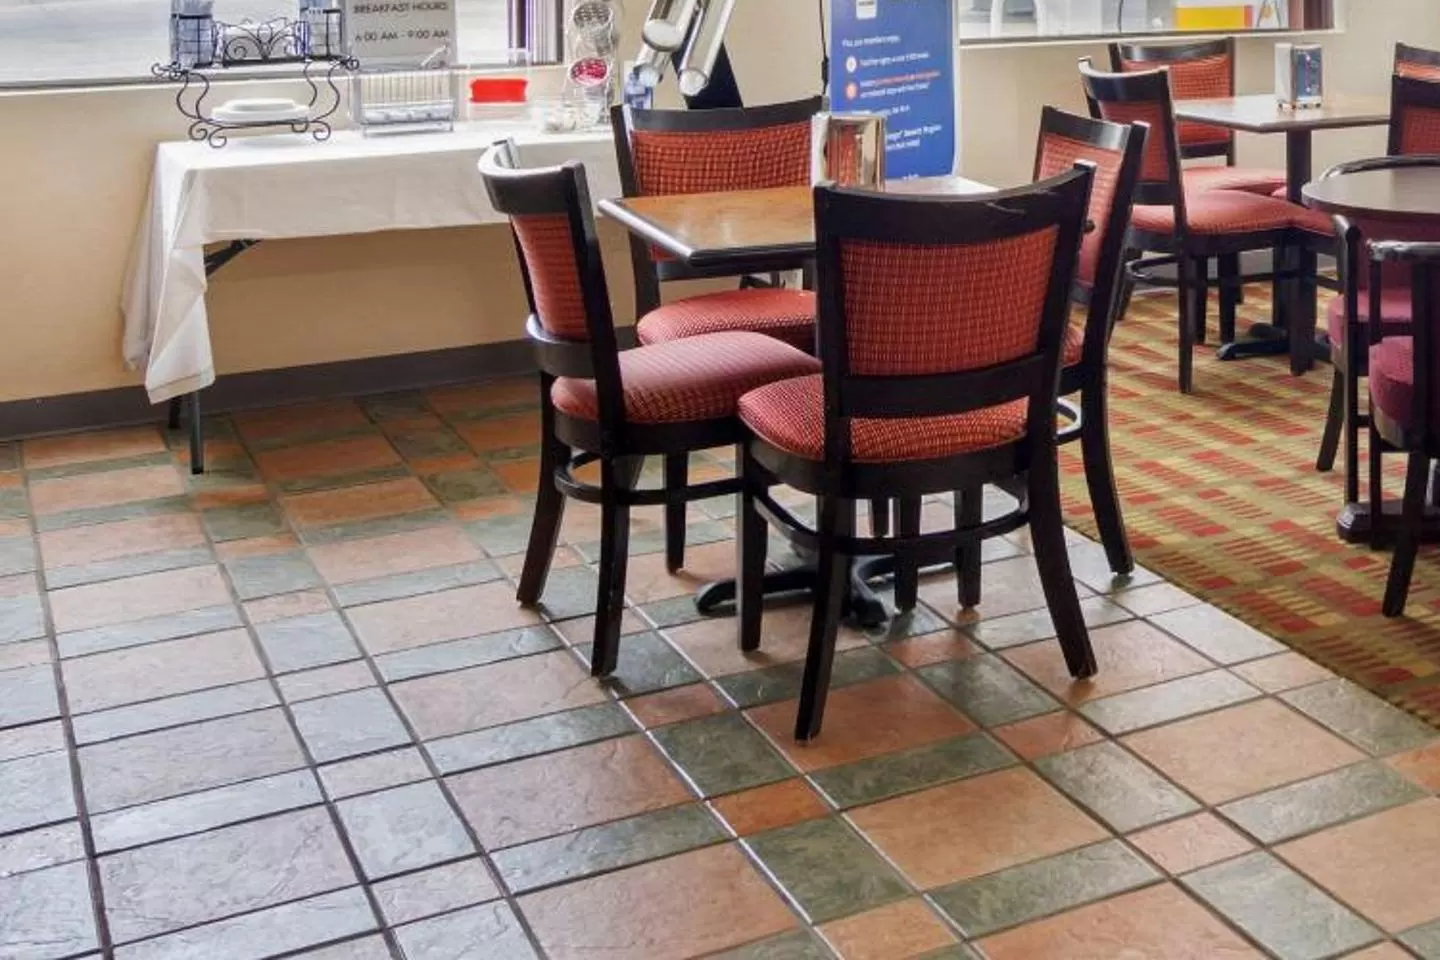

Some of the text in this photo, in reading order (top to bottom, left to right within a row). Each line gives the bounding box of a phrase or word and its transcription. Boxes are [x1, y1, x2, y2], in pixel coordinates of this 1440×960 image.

[353, 1, 448, 14] BREAKFAST HOURS
[380, 30, 399, 41] AM
[432, 28, 450, 39] AM
